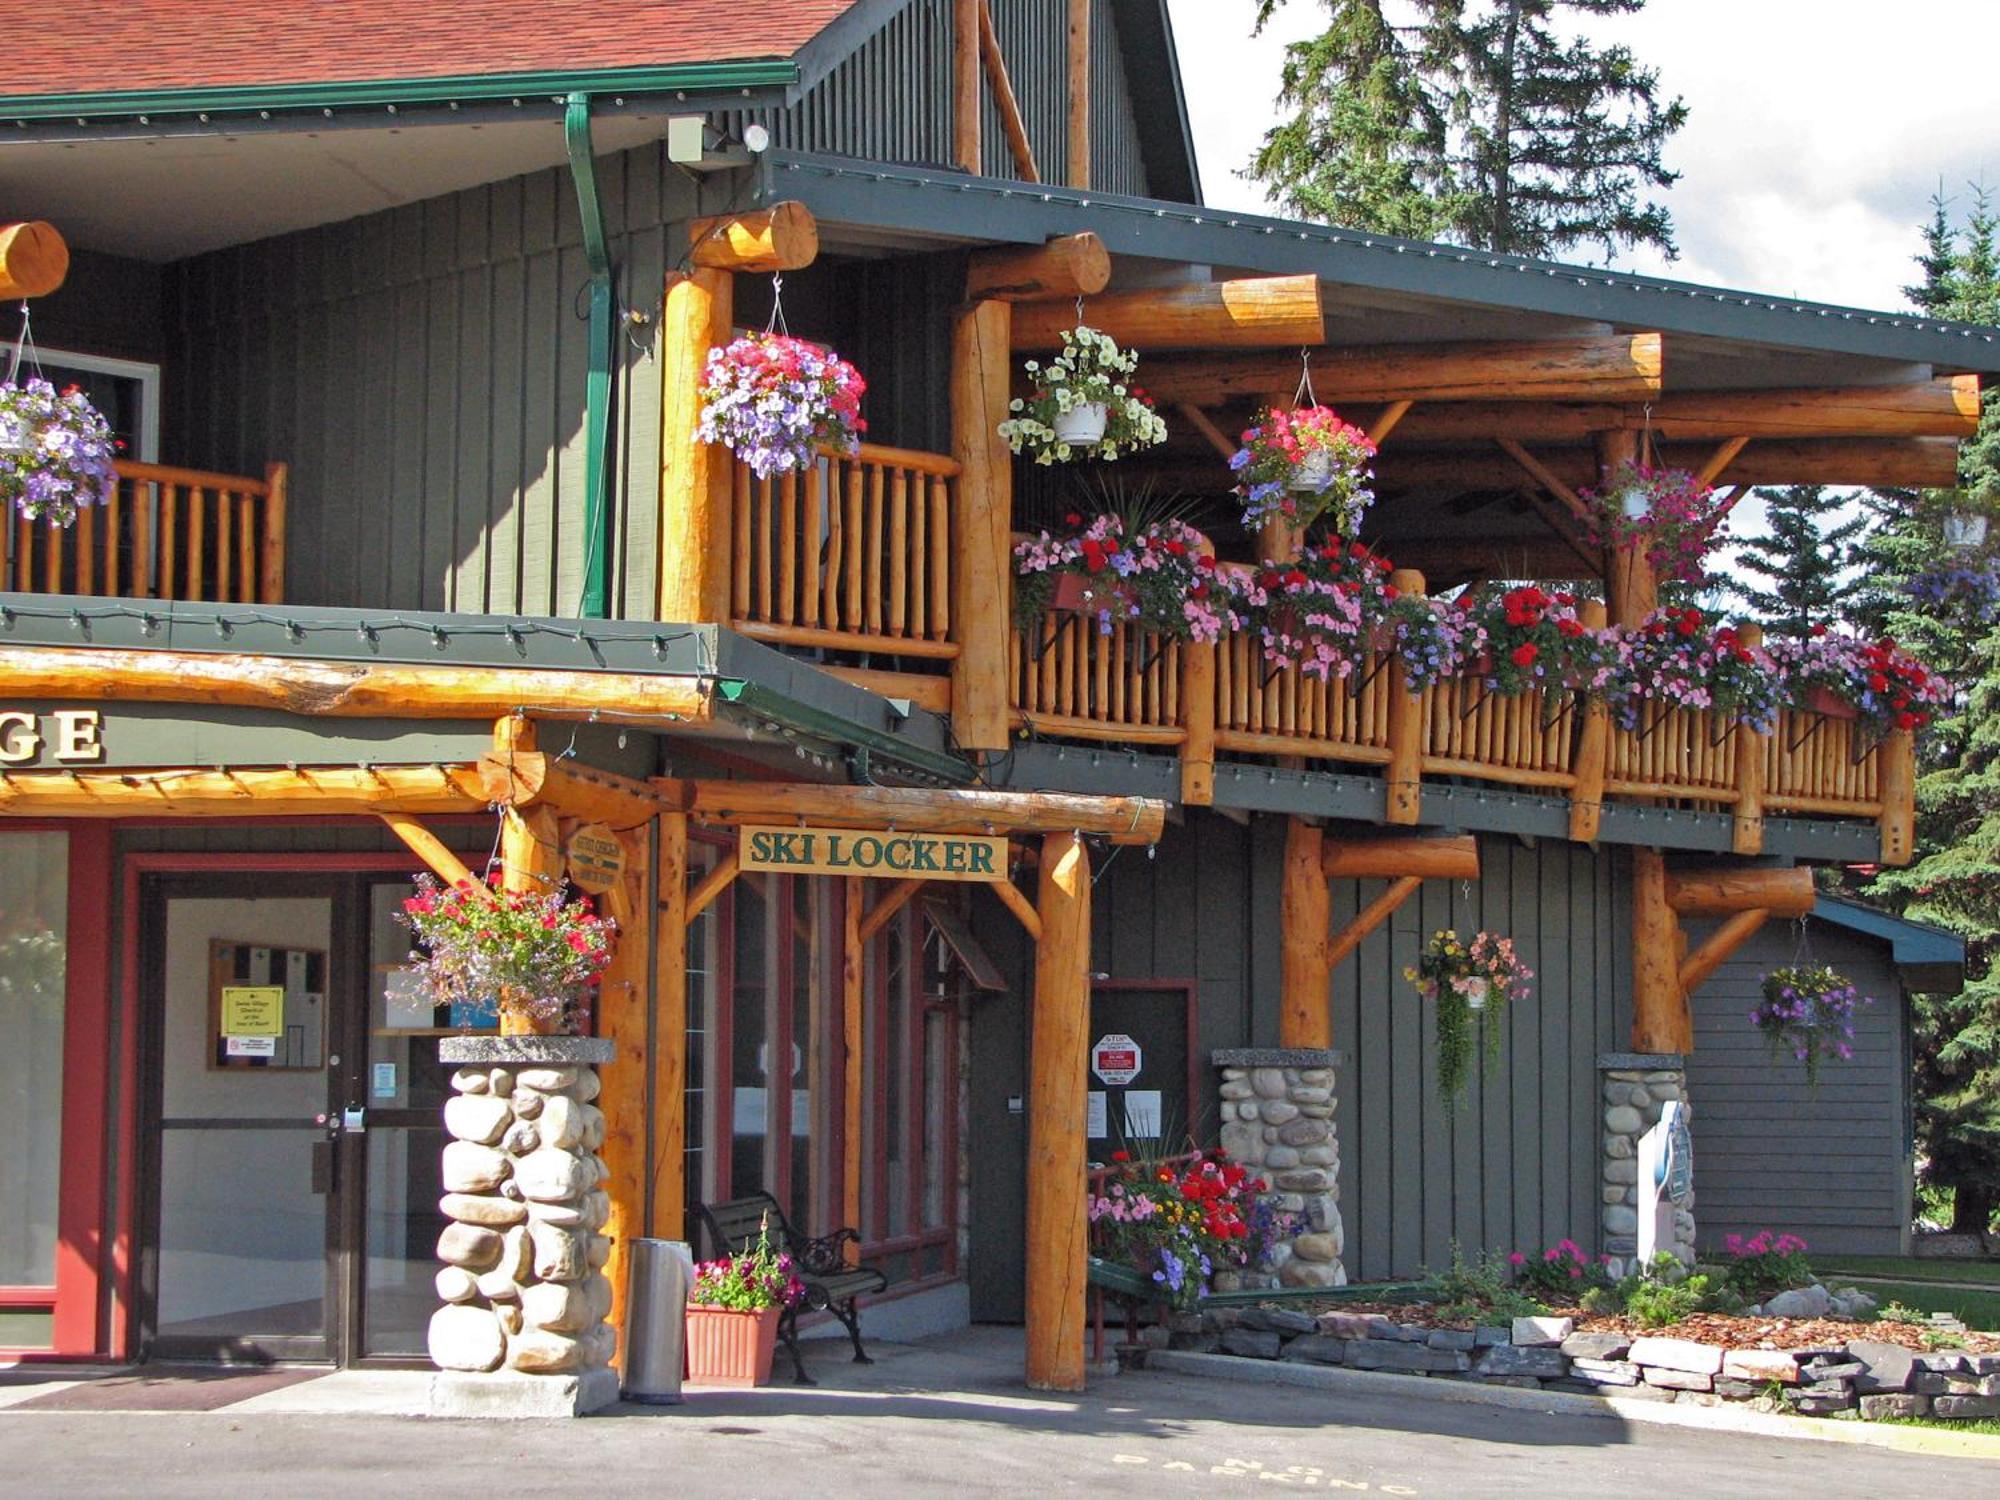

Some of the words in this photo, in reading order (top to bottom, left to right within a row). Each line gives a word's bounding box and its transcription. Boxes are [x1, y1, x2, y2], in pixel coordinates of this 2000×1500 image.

[0, 710, 101, 761] GE
[751, 831, 815, 865] SKI
[826, 835, 995, 874] LOCKER
[1112, 1454, 1417, 1494] PARKING
[1224, 1457, 1323, 1476] NO
